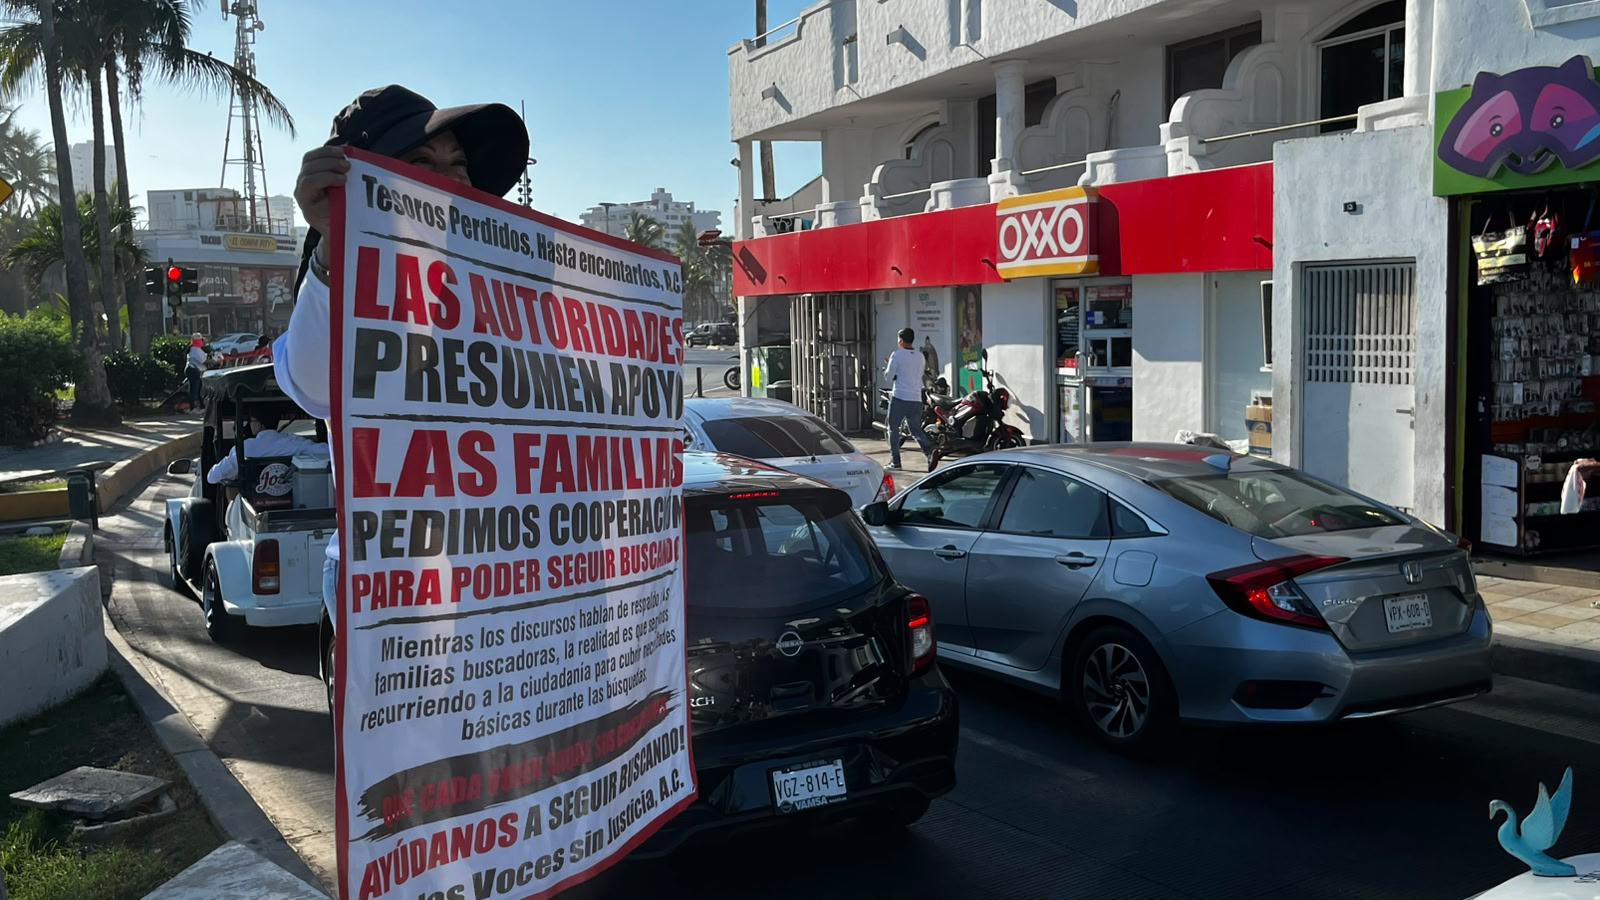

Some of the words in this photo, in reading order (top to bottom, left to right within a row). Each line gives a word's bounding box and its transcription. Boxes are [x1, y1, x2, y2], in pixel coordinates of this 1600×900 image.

[361, 174, 446, 231] Tesoros
[449, 204, 535, 260] Perdidos,
[536, 232, 577, 269] Hasta
[579, 251, 663, 290] encontarlos,
[999, 204, 1084, 261] OXXO
[353, 245, 461, 331] LAS
[467, 272, 684, 367] AUTORIDADES
[352, 327, 606, 414] PRESUMEN
[352, 426, 497, 498] LAS
[512, 432, 684, 494] FAMILIAS
[352, 504, 541, 562] PEDIMOS
[352, 568, 442, 614] PARA
[450, 554, 541, 602] PODER
[547, 548, 616, 590] SEGUIR
[374, 664, 455, 697] familias
[463, 651, 560, 683] buscadoras,
[564, 639, 574, 660] la
[578, 626, 620, 656] realidad
[622, 626, 633, 643] es
[635, 620, 648, 640] que
[381, 630, 474, 663] Mientras
[480, 625, 505, 649] los
[510, 614, 577, 645] discursos
[579, 604, 614, 629] hablan
[617, 600, 629, 620] de
[360, 693, 476, 732] recurriendo
[482, 689, 493, 707] a
[498, 681, 515, 704] la
[520, 662, 592, 700] ciudadanía
[595, 656, 616, 682] para
[461, 711, 531, 741] básicas
[536, 693, 585, 725] durante
[588, 686, 604, 707] las
[359, 811, 519, 900] AYÚDANOS
[523, 804, 543, 841] A
[548, 769, 618, 831] SEGUIR
[618, 724, 685, 795] BUSCANDO!
[419, 774, 482, 812] CADA
[775, 768, 844, 800] VGZ-814-E
[794, 795, 828, 811] VAMSA
[471, 847, 565, 899] Voces
[569, 828, 604, 863] sin
[607, 788, 658, 845] Justicia,
[659, 768, 685, 802] A.C.
